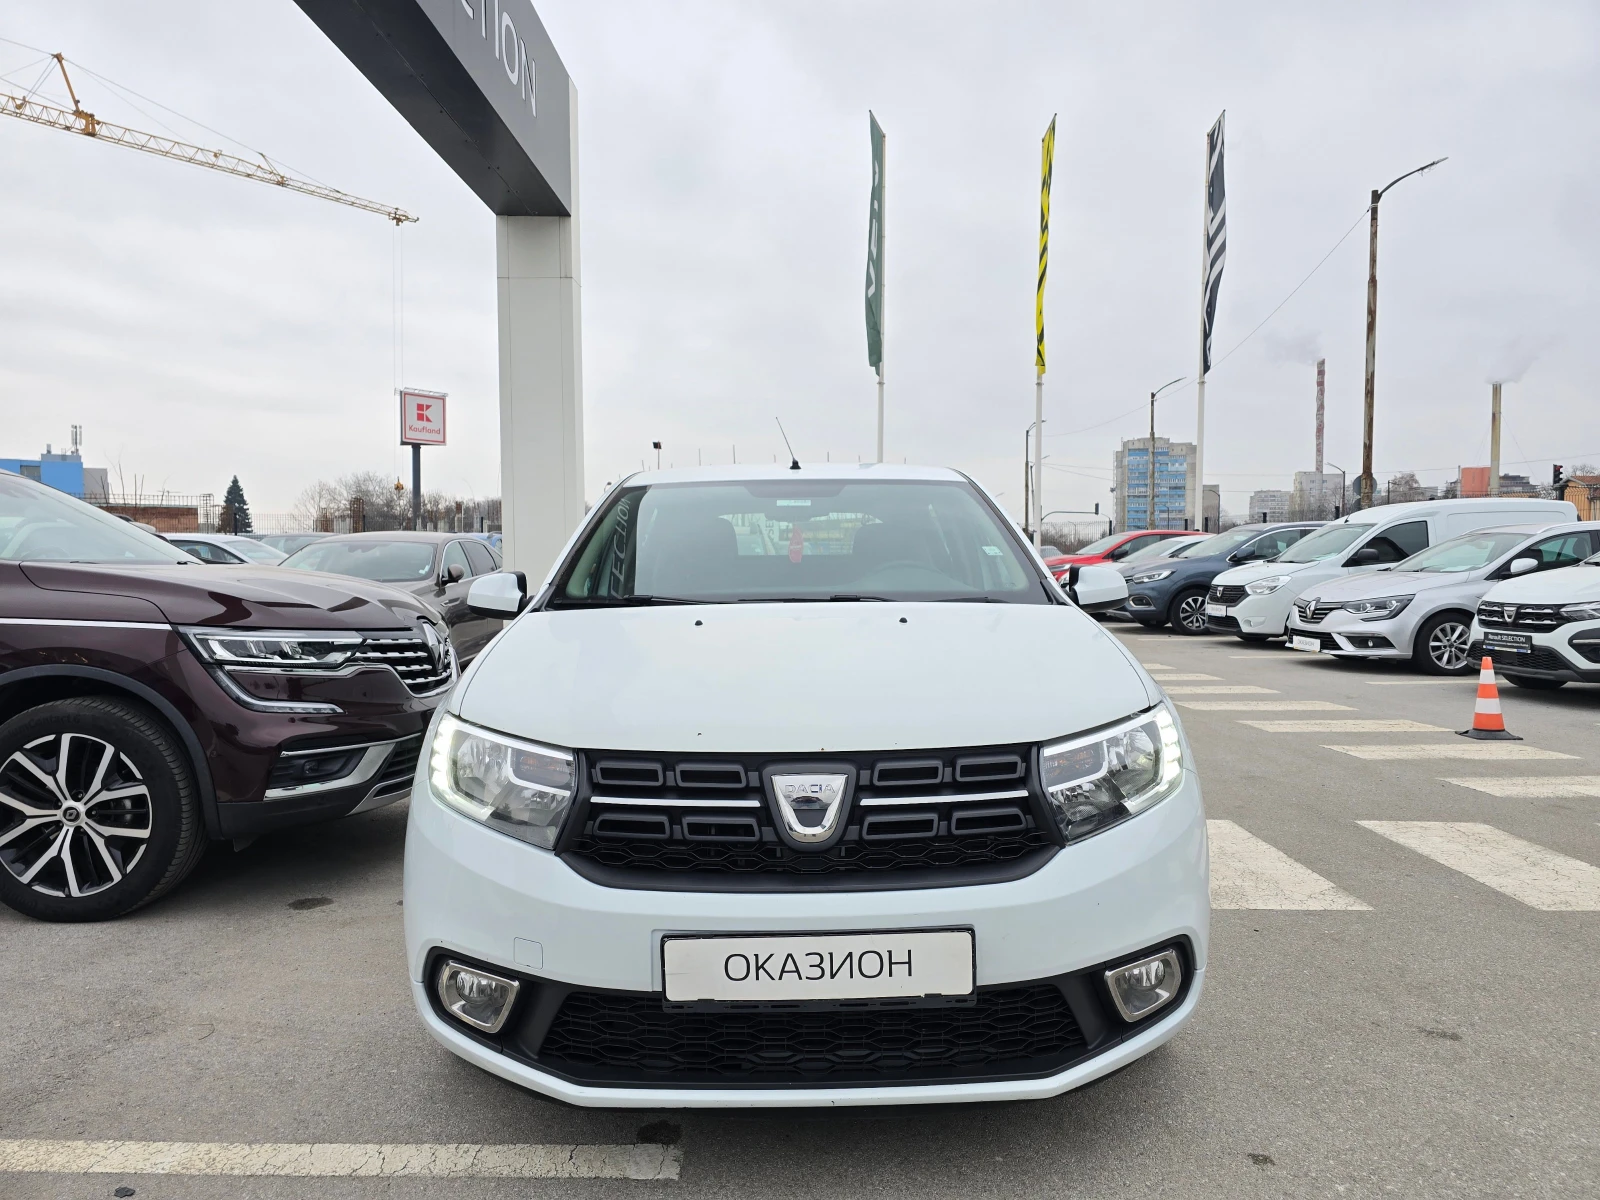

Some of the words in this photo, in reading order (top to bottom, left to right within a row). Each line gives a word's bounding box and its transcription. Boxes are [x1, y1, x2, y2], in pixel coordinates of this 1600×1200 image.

[408, 424, 441, 435] Kaufland
[784, 783, 836, 794] DACIA
[723, 948, 914, 982] ОКАЗИОН
